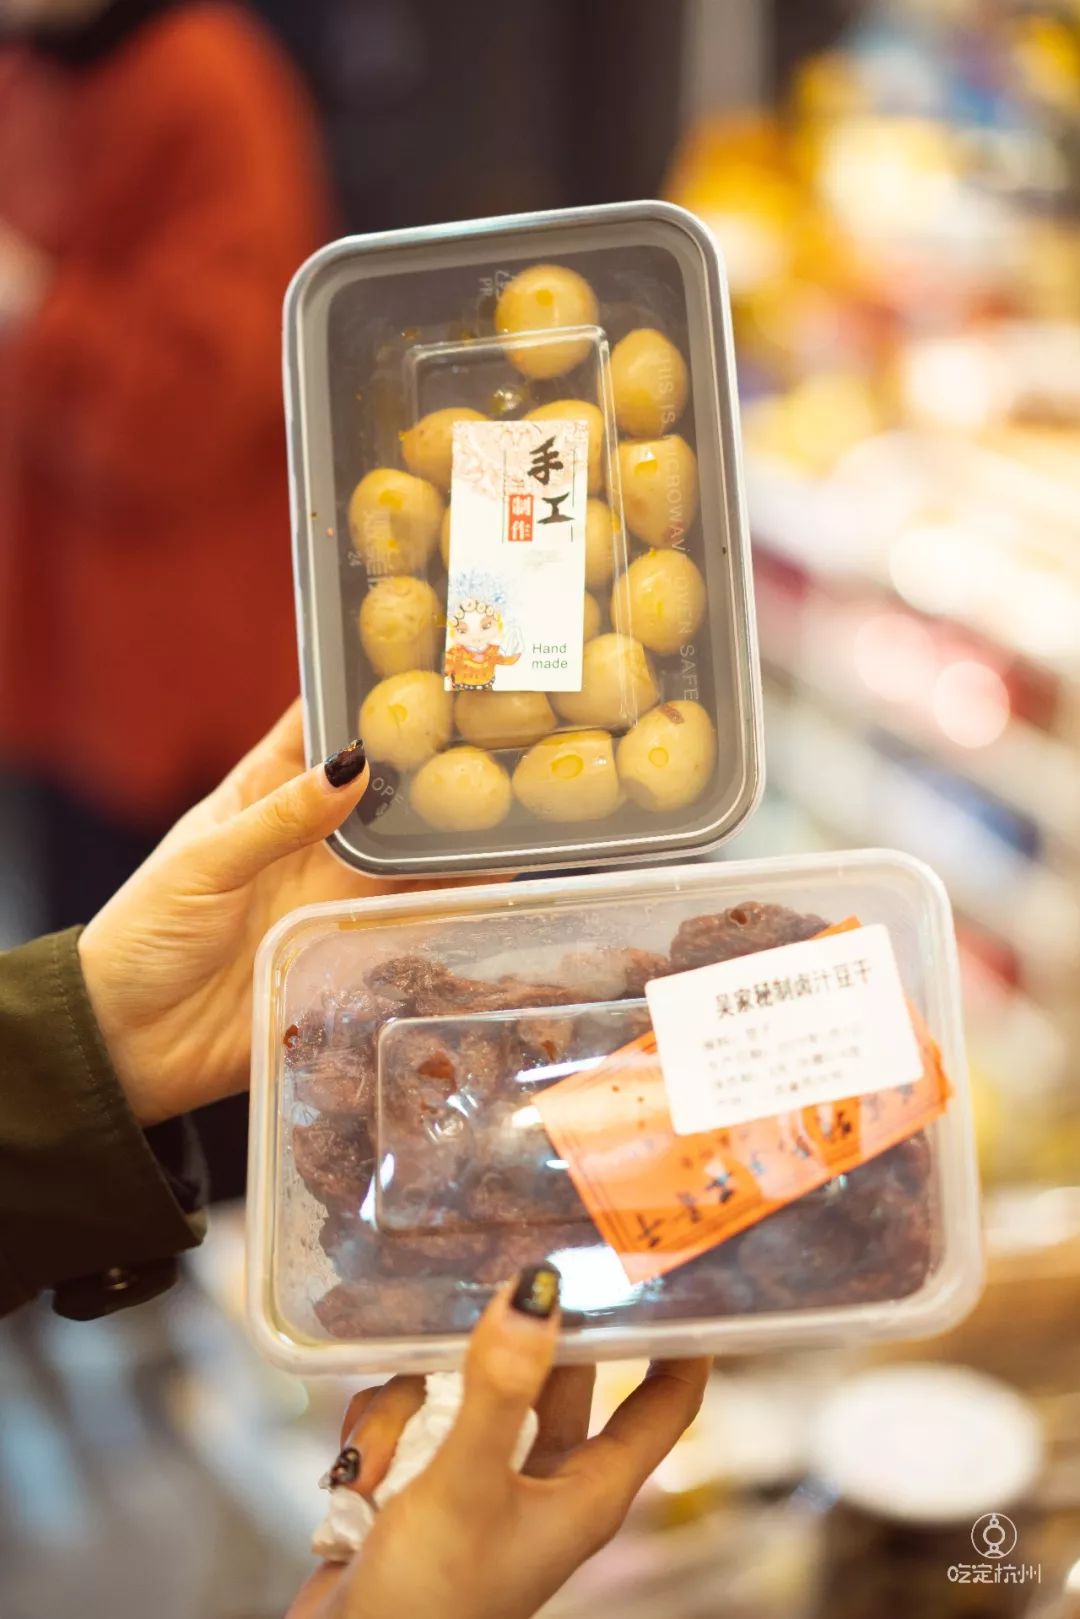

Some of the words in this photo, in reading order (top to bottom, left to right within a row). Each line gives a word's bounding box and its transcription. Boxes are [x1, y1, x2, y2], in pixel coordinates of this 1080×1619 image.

[527, 435, 575, 525] 手工
[510, 495, 533, 540] 制作
[660, 403, 676, 425] IS
[680, 645, 699, 701] SAFE
[531, 658, 568, 669] made
[532, 643, 567, 654] Hand
